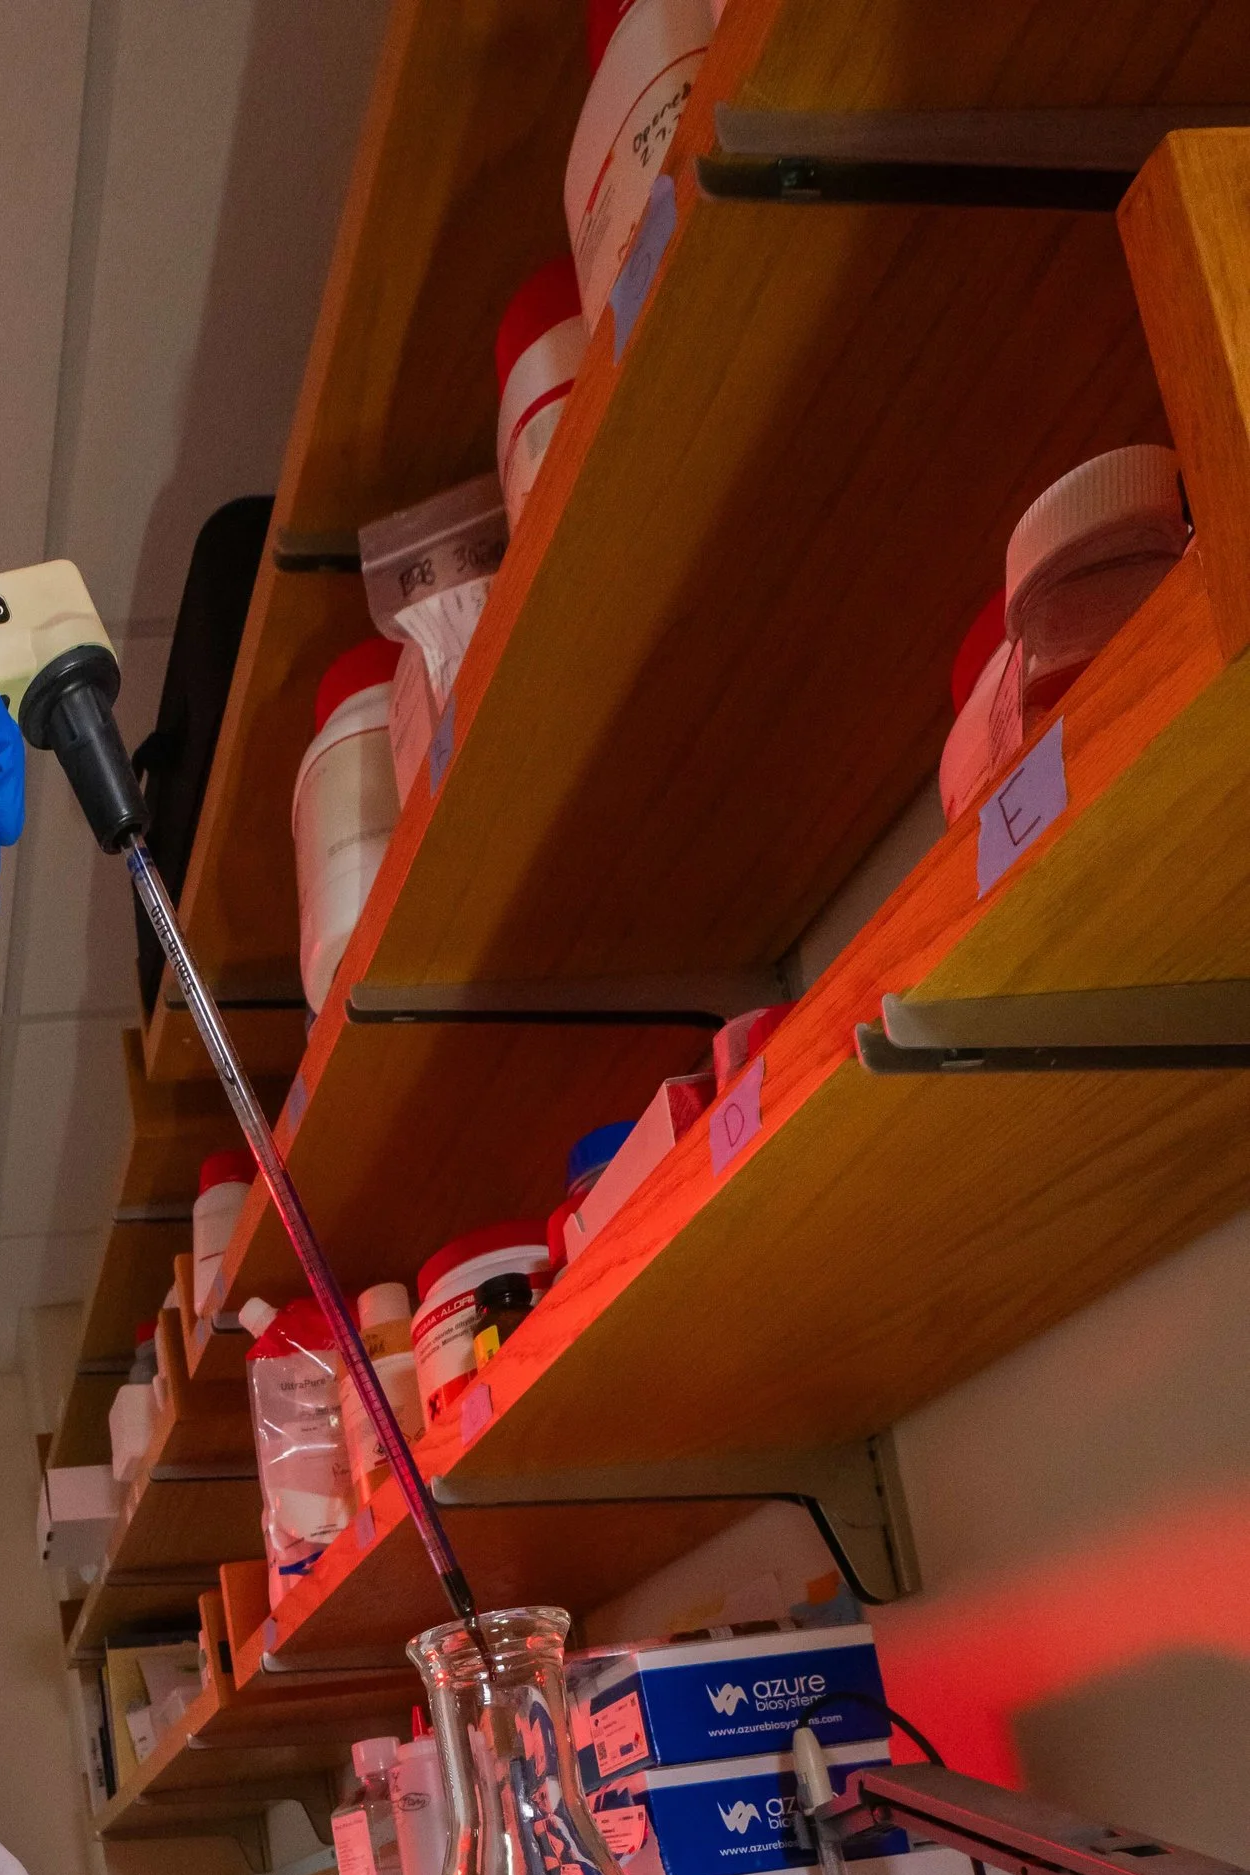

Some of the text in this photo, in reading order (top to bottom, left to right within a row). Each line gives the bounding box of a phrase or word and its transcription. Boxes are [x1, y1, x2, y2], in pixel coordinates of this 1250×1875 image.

[998, 767, 1041, 846] E
[724, 1103, 745, 1148] D
[753, 1674, 826, 1699] azure
[755, 1693, 827, 1712] biosystem
